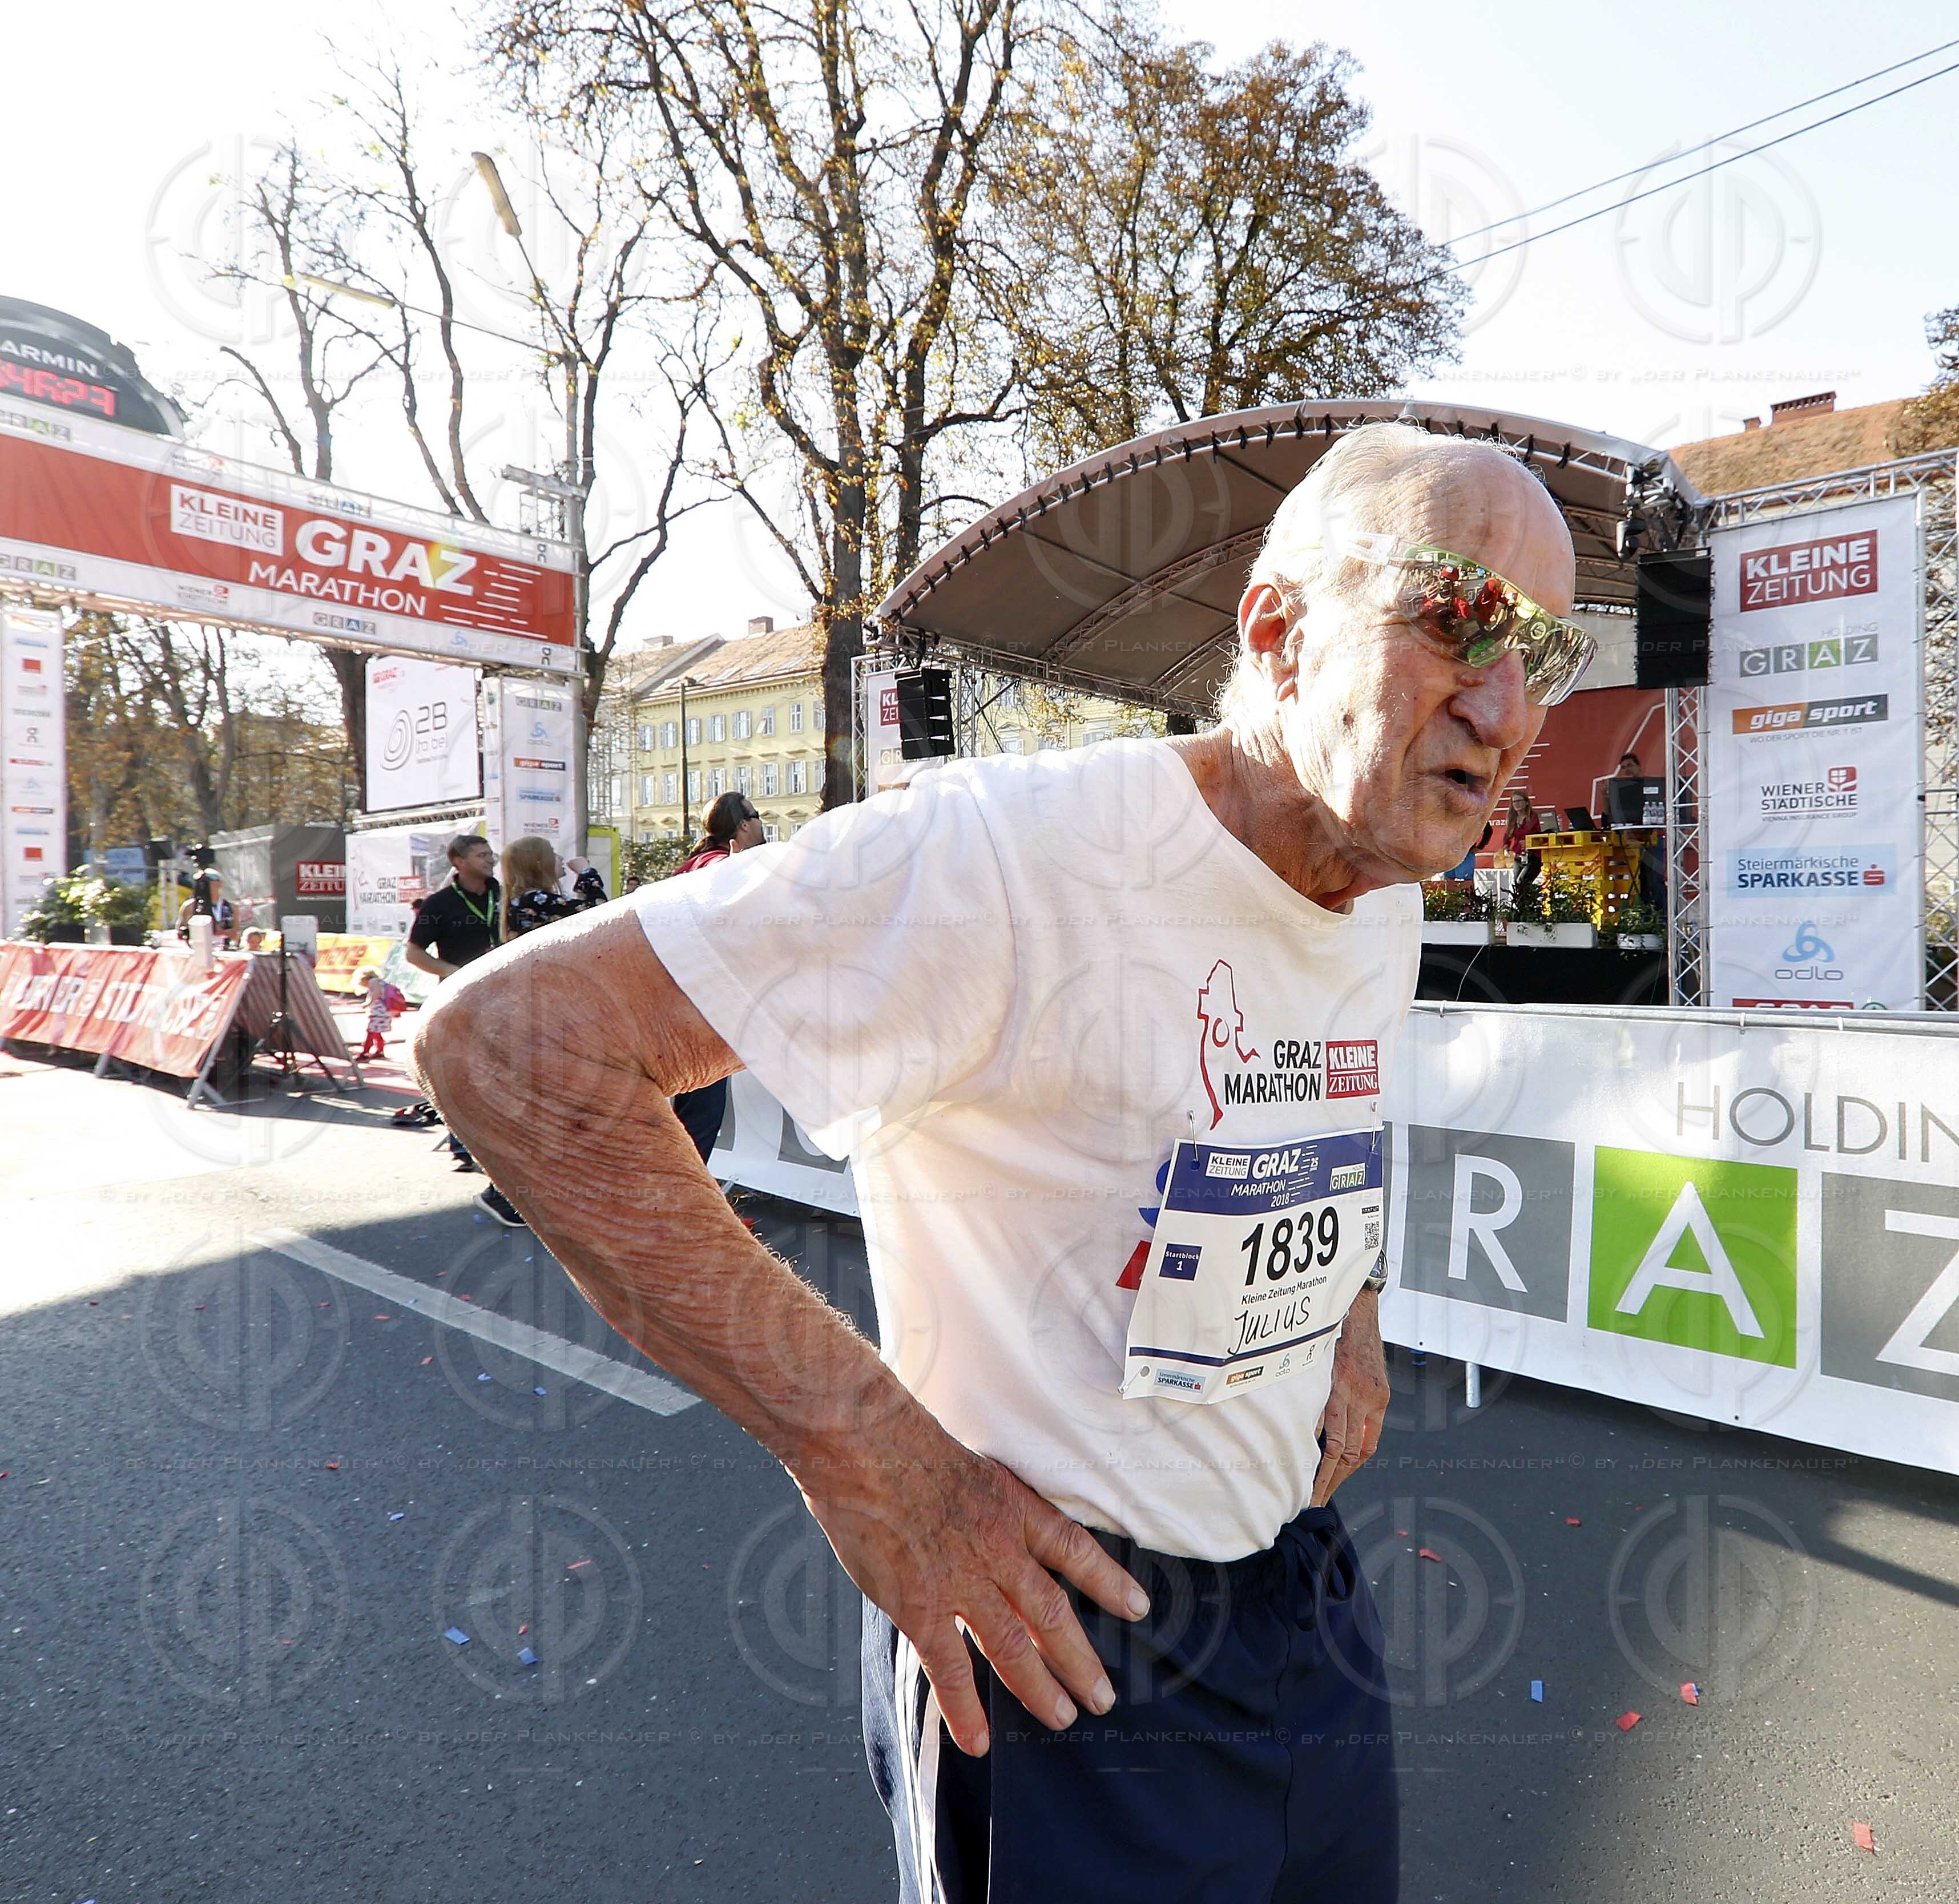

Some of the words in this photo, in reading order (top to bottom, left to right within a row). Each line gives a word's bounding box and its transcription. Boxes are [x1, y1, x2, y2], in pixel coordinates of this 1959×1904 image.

[179, 493, 276, 530] KLEINE
[178, 514, 276, 549] ZEITUNG
[295, 519, 477, 596] GRAZ
[1746, 538, 1871, 580] KLEINE
[248, 561, 427, 616] MARATHON
[1747, 564, 1871, 604] ZEITUNG
[1743, 638, 1872, 675] GRAZ
[1749, 708, 1803, 730] giga
[1808, 700, 1878, 722] sport
[1761, 782, 1825, 797] WIENER
[1762, 794, 1857, 810] STÄDTISCHE
[1738, 856, 1859, 871] Steiermärkische
[1738, 871, 1859, 889] SPARKASSE
[1775, 966, 1843, 981] odlo
[1274, 1040, 1321, 1069] GRAZ
[1329, 1045, 1376, 1070] KLEINE
[1224, 1073, 1321, 1105] MARATHON
[1329, 1073, 1377, 1094] ZEITUNG
[1209, 1165, 1247, 1176] ZEITUNG
[1211, 1156, 1248, 1167] KLEINE
[1252, 1148, 1302, 1179] GRAZ
[1231, 1179, 1286, 1197] MARATHON
[1331, 1172, 1364, 1189] GRAZ
[1270, 1193, 1290, 1208] 2018
[1165, 1250, 1199, 1260] Startblock
[1241, 1206, 1339, 1286] 1839
[1176, 1260, 1183, 1271] 1
[1447, 1152, 1959, 1375] RAZ
[1241, 1293, 1267, 1305] Kleine
[1268, 1284, 1296, 1300] Zeitung
[1297, 1276, 1327, 1292] Marathon
[1227, 1296, 1311, 1356] JULIUS
[1157, 1377, 1194, 1389] SPARKASSE
[1244, 1369, 1261, 1379] sport
